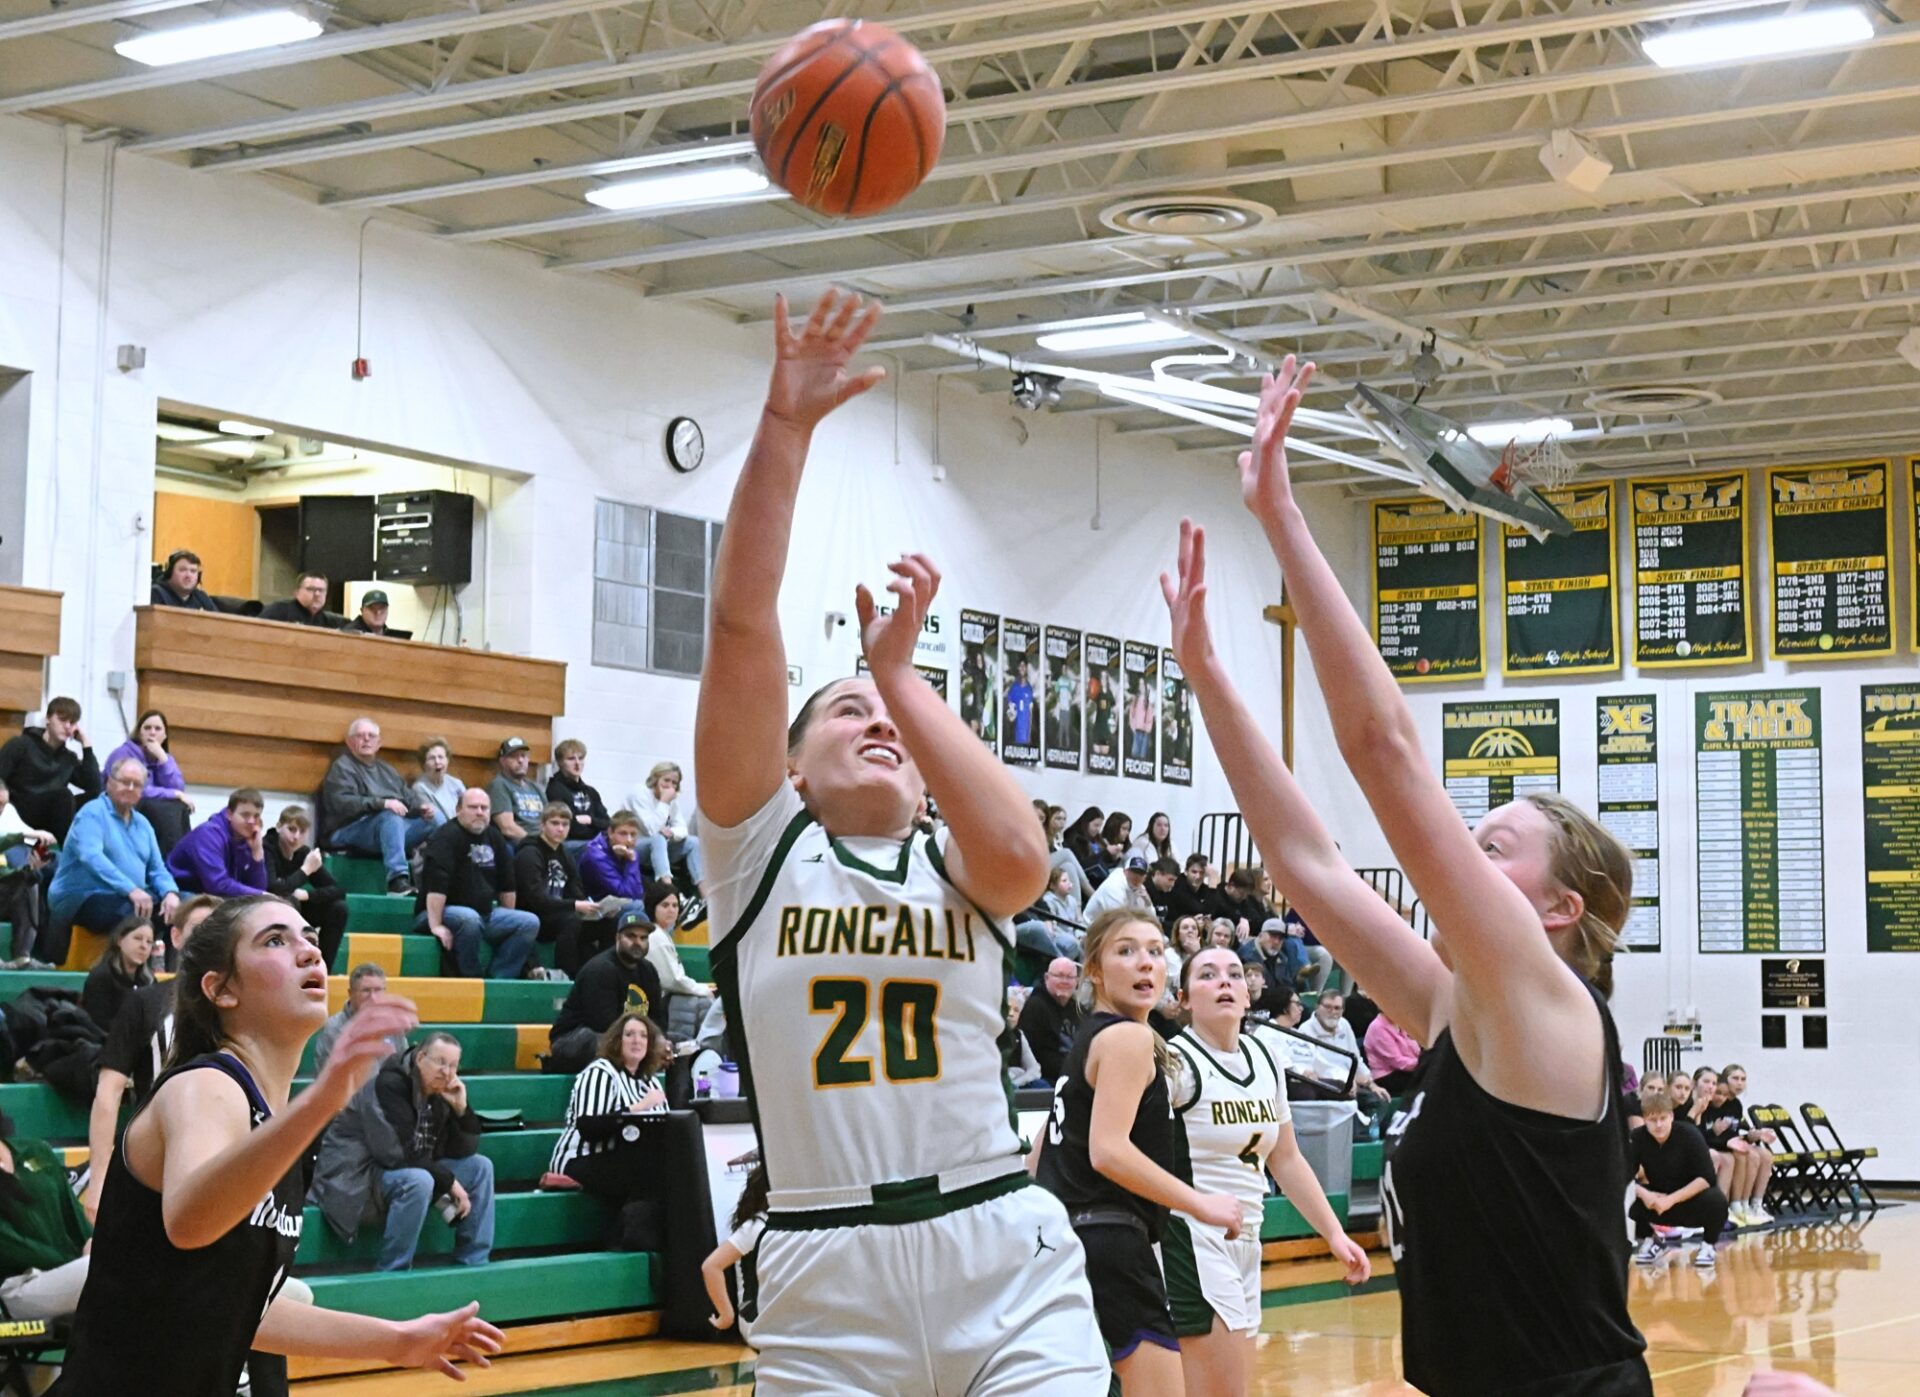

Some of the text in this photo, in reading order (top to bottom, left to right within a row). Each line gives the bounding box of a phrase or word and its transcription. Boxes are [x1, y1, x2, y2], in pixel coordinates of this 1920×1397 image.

[1635, 478, 1741, 513] GOLF
[1778, 497, 1882, 513] CONFERENCE CHAMPS
[1639, 508, 1738, 524] CONFERENCE CHAMPS
[1796, 559, 1866, 572] STATE FINISH
[1656, 569, 1723, 582] STATE FINISH
[1525, 579, 1590, 592] STATE FINISH
[1396, 588, 1459, 601] STATE FINISH
[1836, 594, 1882, 607] 2014-7TH
[1837, 605, 1885, 618] 2020-7TH
[1837, 616, 1886, 629] 2023-7TH
[1638, 640, 1744, 656] Roncalli High School
[1778, 632, 1887, 649] Roncalli High School
[1429, 659, 1451, 672] High
[1452, 656, 1479, 669] School
[1509, 653, 1545, 665] Roncalli
[1560, 650, 1581, 664] High
[1582, 648, 1611, 661] School
[1710, 698, 1809, 722] TRACK
[1444, 709, 1558, 729] BASKETBALL
[1599, 703, 1654, 736] XC
[1704, 718, 1813, 741] & FIELD
[1702, 742, 1731, 751] GIRLS
[1741, 740, 1768, 750] BOYS
[1770, 739, 1815, 749] RECORDS
[777, 904, 976, 963] RONCALLI
[808, 975, 943, 1091] 20
[1237, 1131, 1263, 1173] 4
